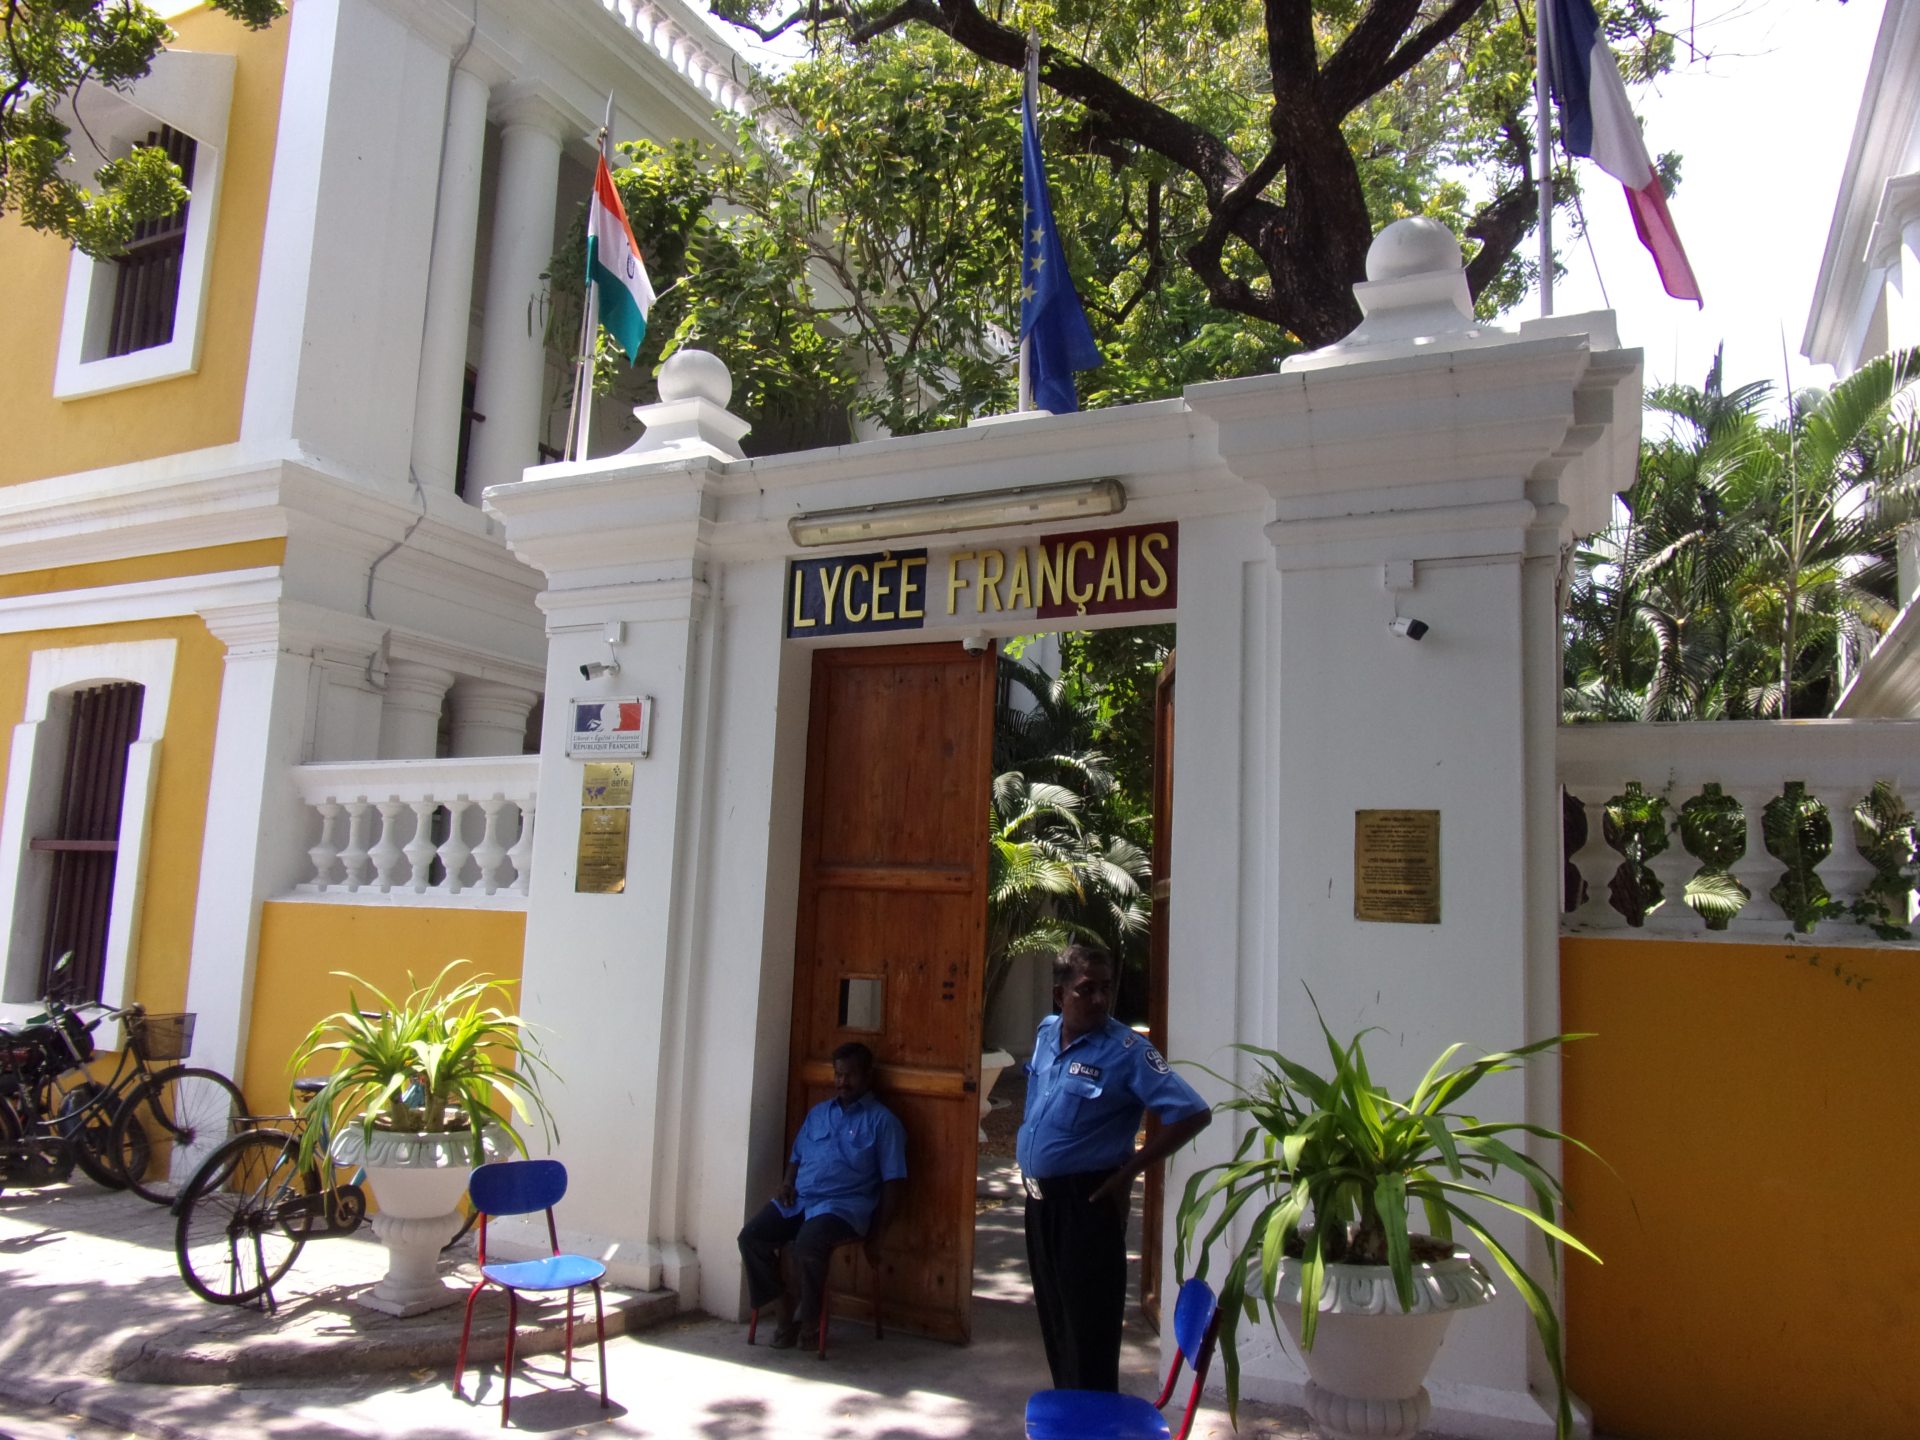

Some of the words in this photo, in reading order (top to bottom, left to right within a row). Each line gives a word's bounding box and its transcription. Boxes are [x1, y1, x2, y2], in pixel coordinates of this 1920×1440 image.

[793, 550, 927, 628] LYCÉE
[946, 533, 1169, 616] FRANÇAIS
[611, 777, 629, 787] aefe
